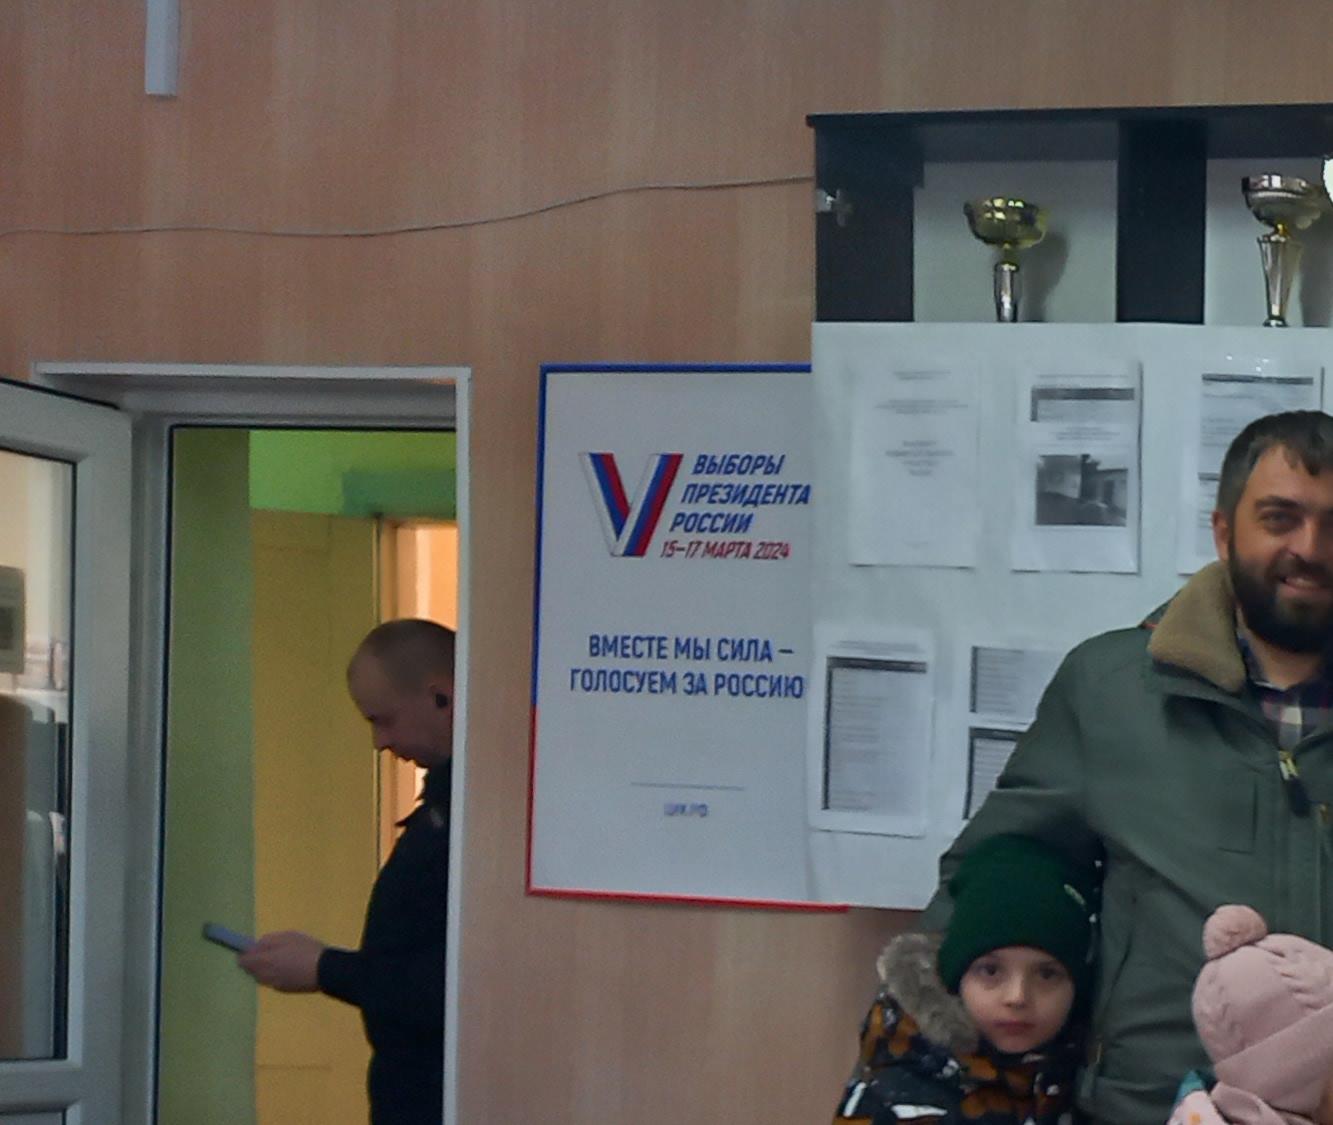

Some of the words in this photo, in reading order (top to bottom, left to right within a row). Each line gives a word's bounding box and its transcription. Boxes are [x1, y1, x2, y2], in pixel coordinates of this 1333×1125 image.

[692, 453, 786, 476] ВЫБОРЫ
[680, 482, 812, 508] ПРЕЗИДЕНТА
[669, 511, 755, 534] РОССИИ
[701, 540, 753, 559] МАРТА
[753, 540, 791, 560] 2024
[588, 634, 668, 659] ВМЕСТЕ
[674, 636, 711, 661] МЫ
[717, 638, 773, 662] СИЛА
[570, 668, 677, 694] ГОЛОСУЕМ
[683, 671, 708, 695] ЗА
[714, 672, 806, 699] РОССИЮ
